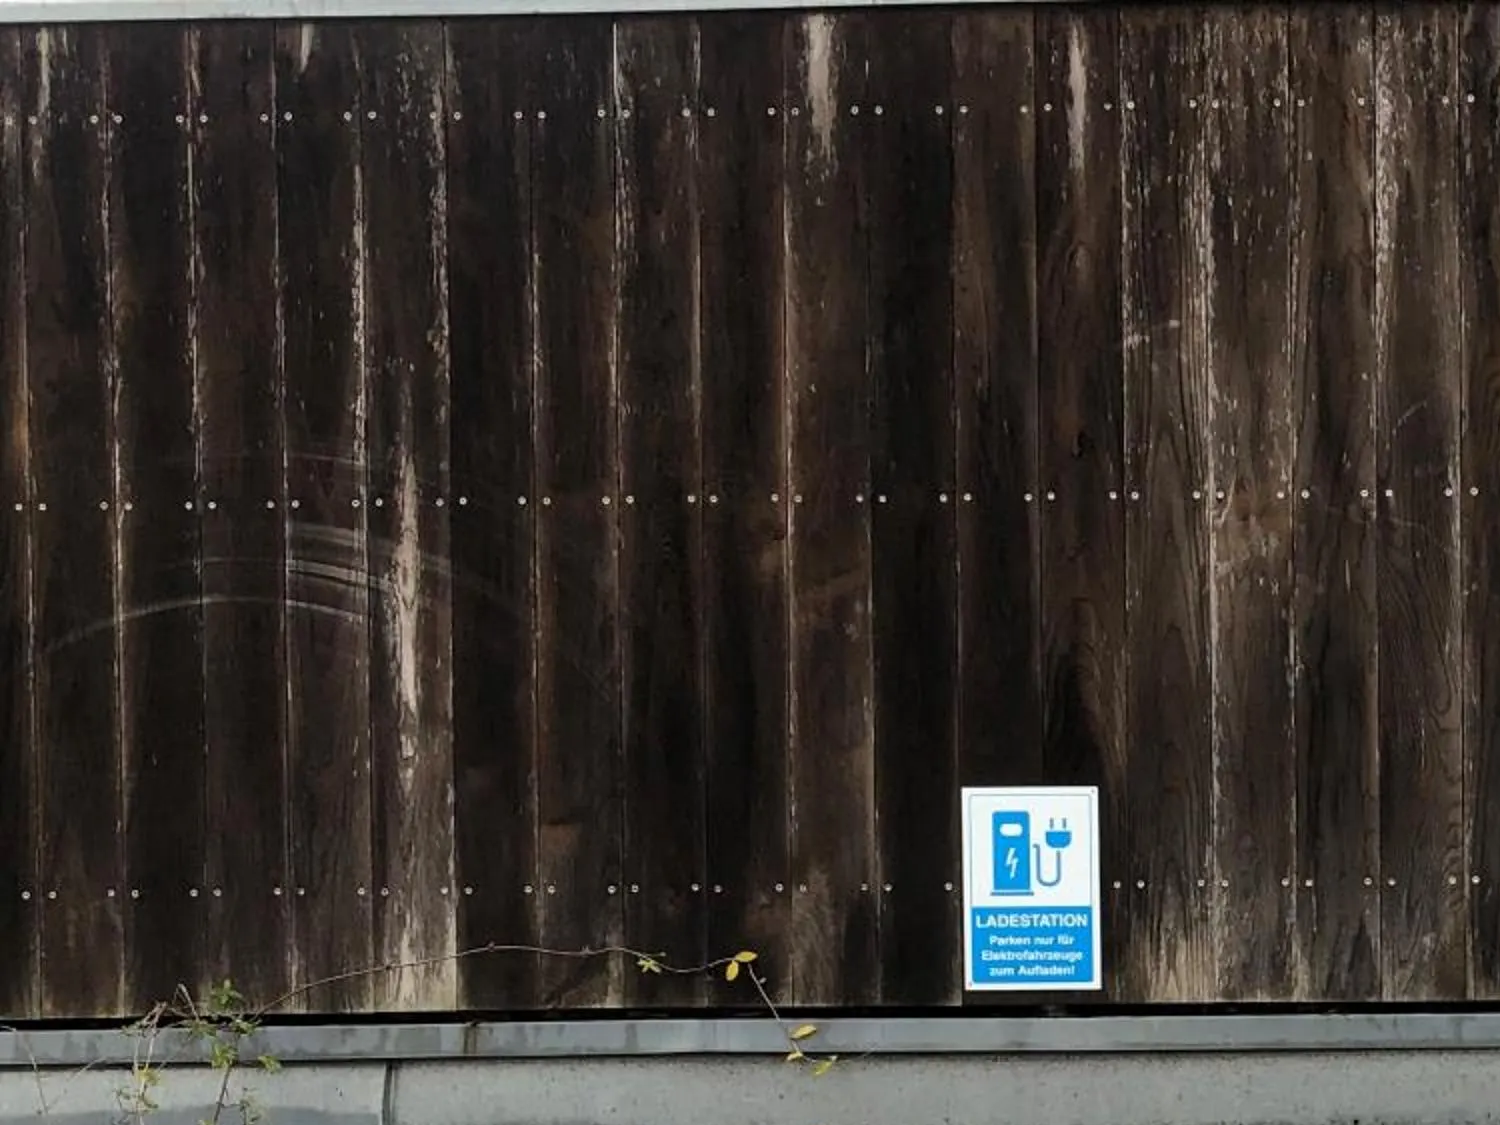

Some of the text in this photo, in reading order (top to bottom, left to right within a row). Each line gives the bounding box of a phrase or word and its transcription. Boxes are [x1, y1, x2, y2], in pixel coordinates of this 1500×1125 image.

[976, 914, 1088, 928] LADESTATION
[989, 934, 1075, 945] Parken nur für
[981, 949, 1083, 962] Elektrofahrzeuge
[989, 964, 1075, 976] zum Aufladen!
